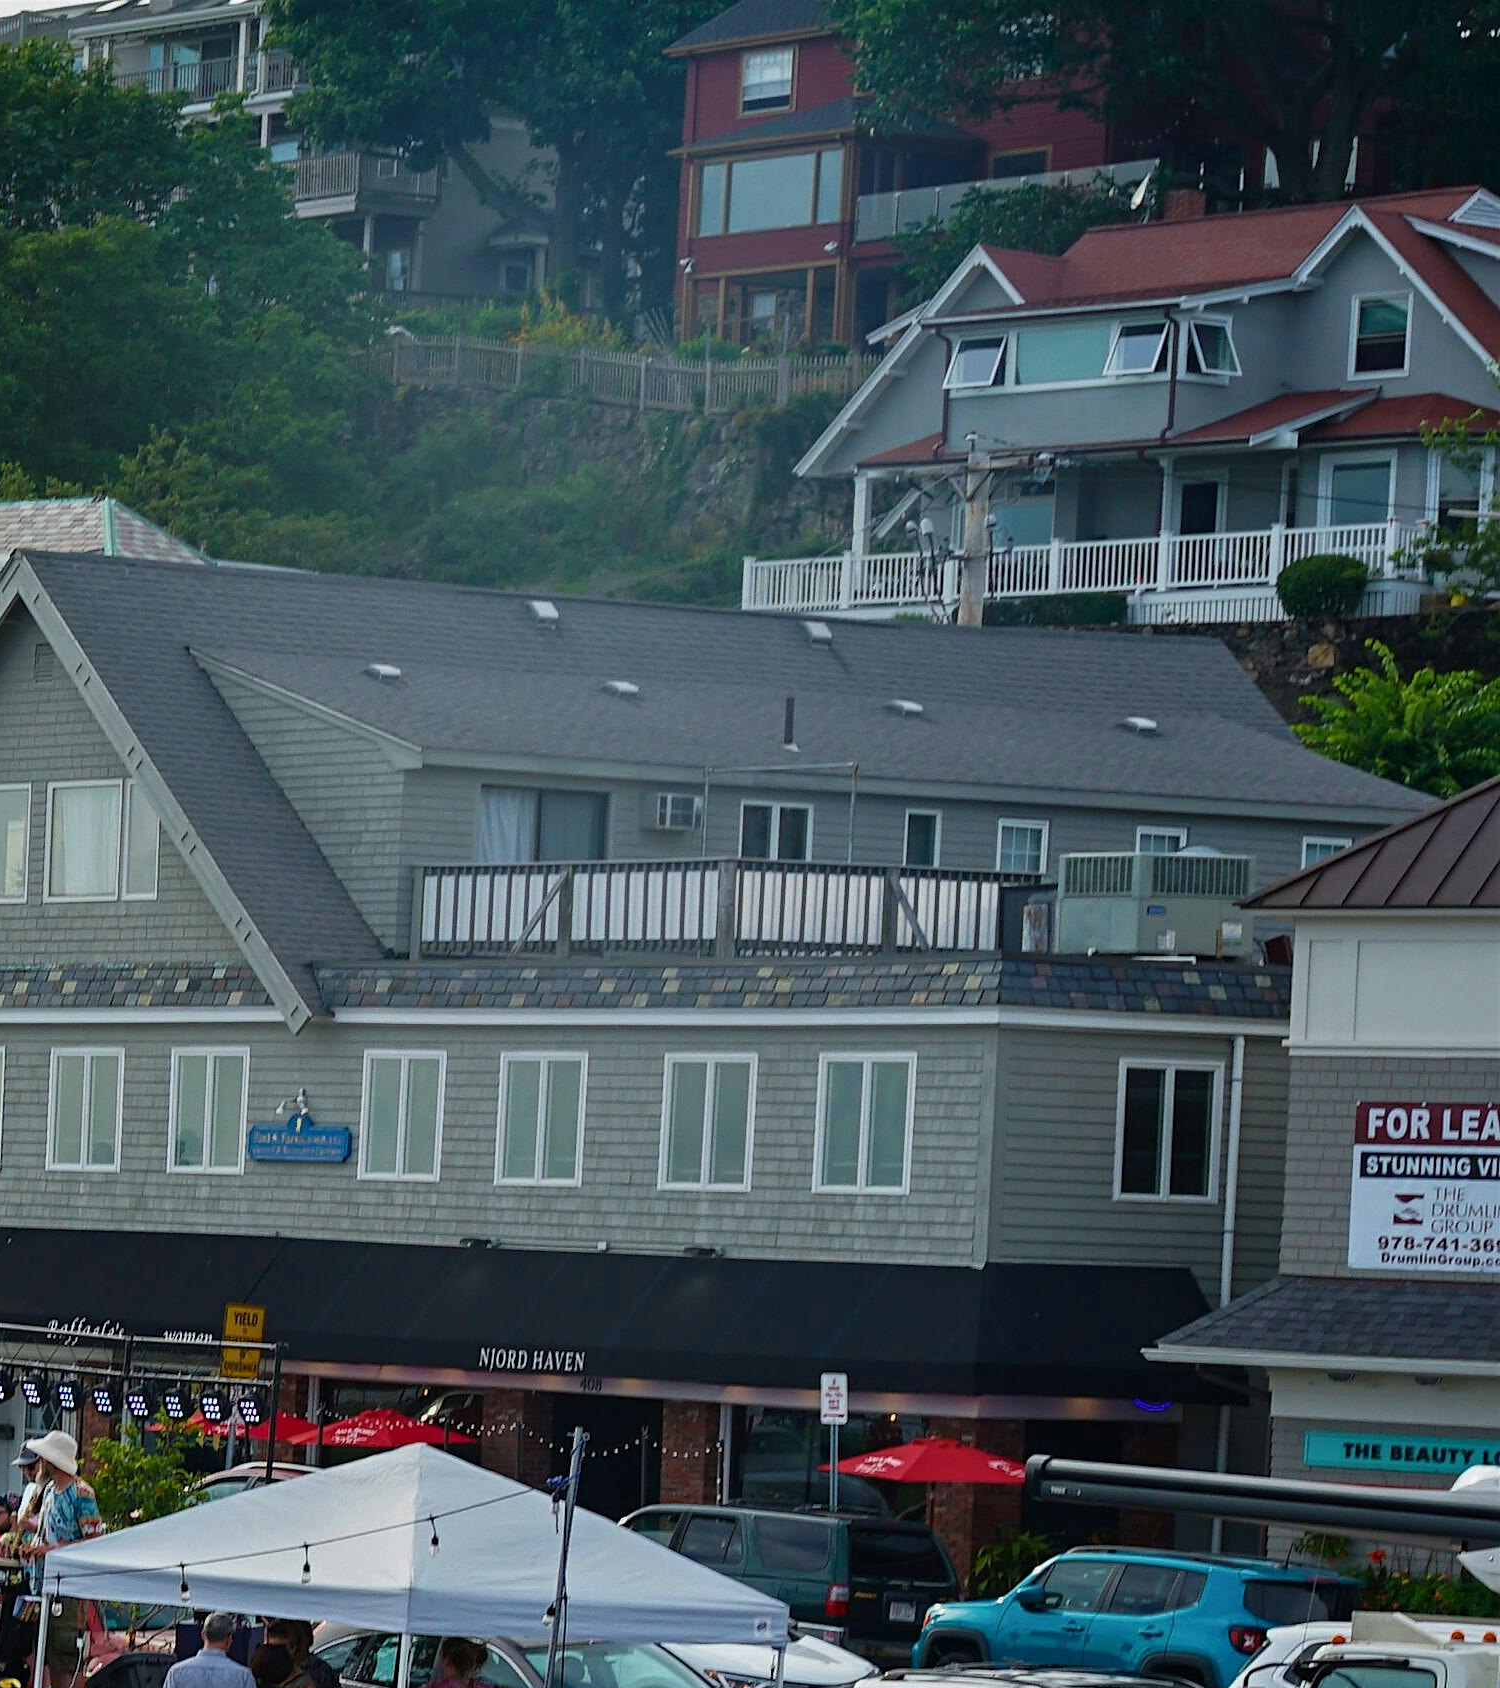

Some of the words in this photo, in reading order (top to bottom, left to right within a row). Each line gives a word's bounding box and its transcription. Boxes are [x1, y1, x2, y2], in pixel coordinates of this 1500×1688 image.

[1367, 1107, 1431, 1141] FOR
[1366, 1155, 1472, 1177] STUNNING
[1434, 1187, 1465, 1202] THE
[1431, 1219, 1494, 1235] GROUP
[233, 1311, 258, 1327] YIELD
[479, 1347, 528, 1372] NJORD
[531, 1350, 586, 1372] HAVEN
[1343, 1443, 1381, 1459] THE
[1389, 1444, 1476, 1466] BEAUTY
